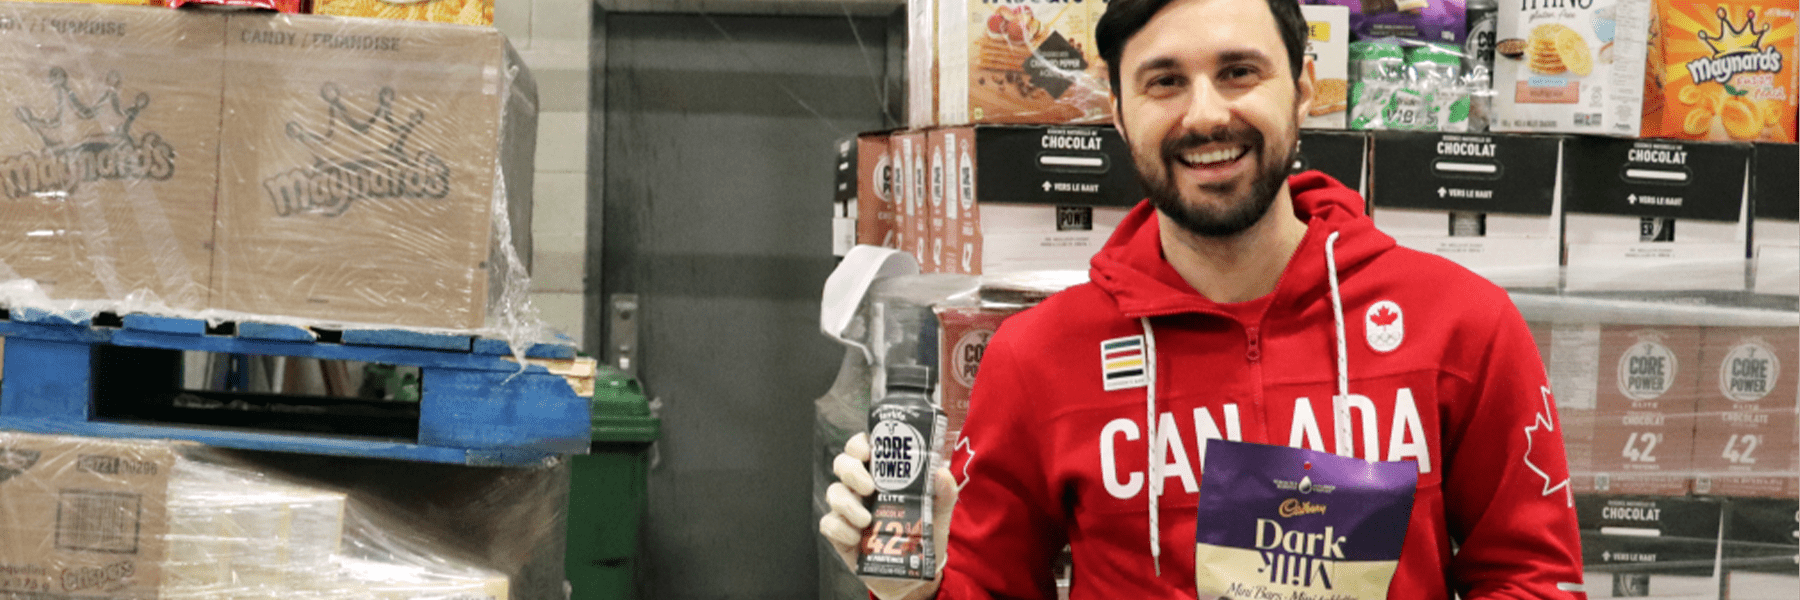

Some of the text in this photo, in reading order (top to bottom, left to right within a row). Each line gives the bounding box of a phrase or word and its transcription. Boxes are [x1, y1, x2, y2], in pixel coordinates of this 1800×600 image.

[241, 29, 295, 45] CANDY
[313, 33, 400, 50] FRIANDISE
[1041, 135, 1102, 150] CHOCOLAT
[1437, 142, 1497, 157] CHOCOLAT
[1628, 149, 1688, 164] CHOCOLAT
[964, 343, 985, 362] CO
[1629, 355, 1666, 376] CORE
[1731, 357, 1768, 378] CORE
[1628, 375, 1665, 391] POWER
[1729, 379, 1767, 393] POWER
[874, 436, 912, 460] CORE
[1100, 388, 1431, 499] CANADA
[875, 460, 911, 478] POWER
[878, 493, 905, 503] ELITE
[1602, 506, 1661, 521] CHOCOLAT
[1255, 518, 1347, 559] Dark
[1257, 550, 1332, 590] Milk
